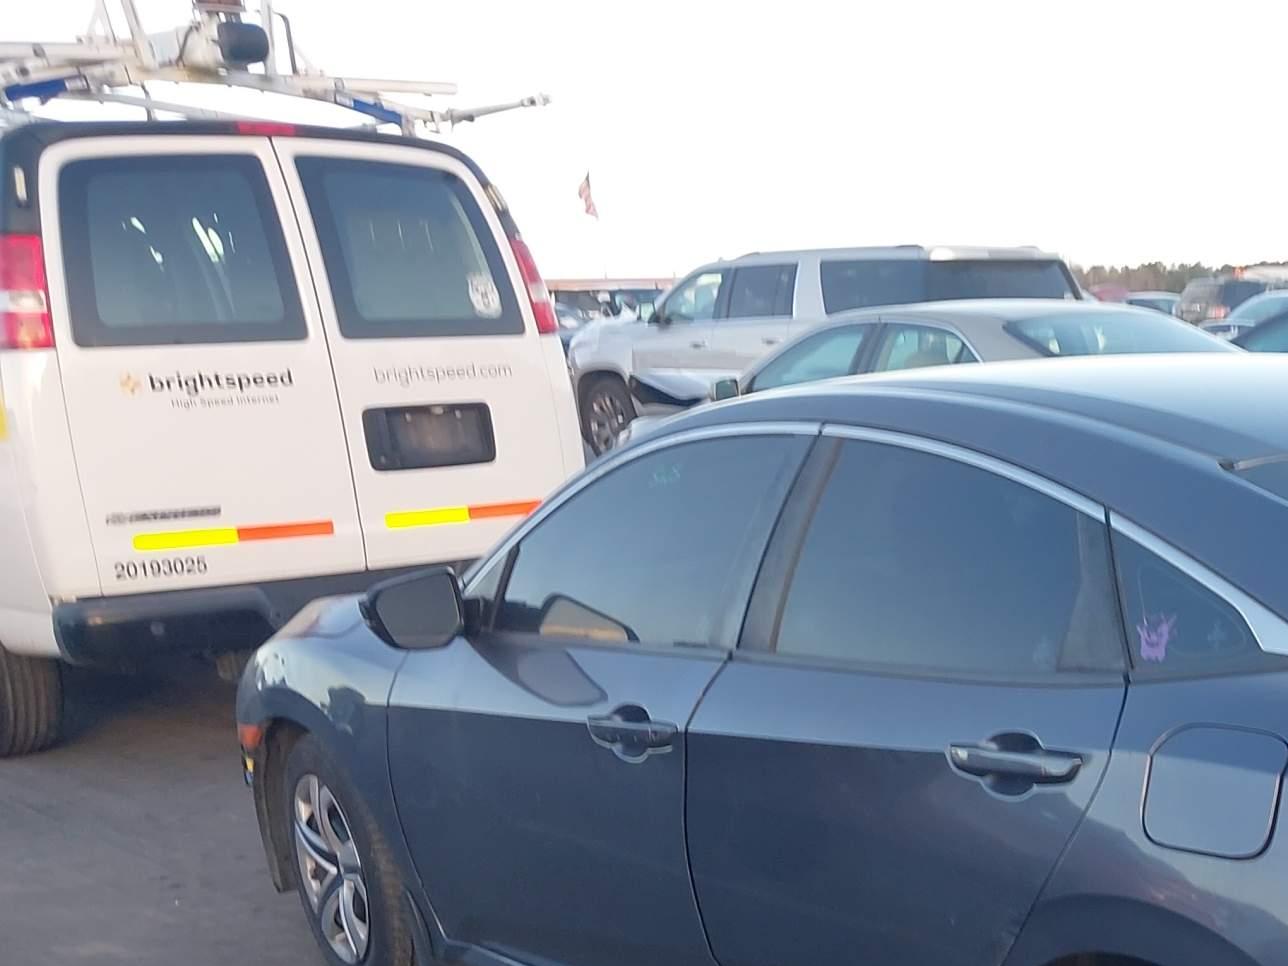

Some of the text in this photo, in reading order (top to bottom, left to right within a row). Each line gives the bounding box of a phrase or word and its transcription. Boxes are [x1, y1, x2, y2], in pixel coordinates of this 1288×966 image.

[148, 367, 293, 396] brightspeed
[374, 362, 512, 388] brightspeed.com
[170, 394, 280, 412] High Speed Internet
